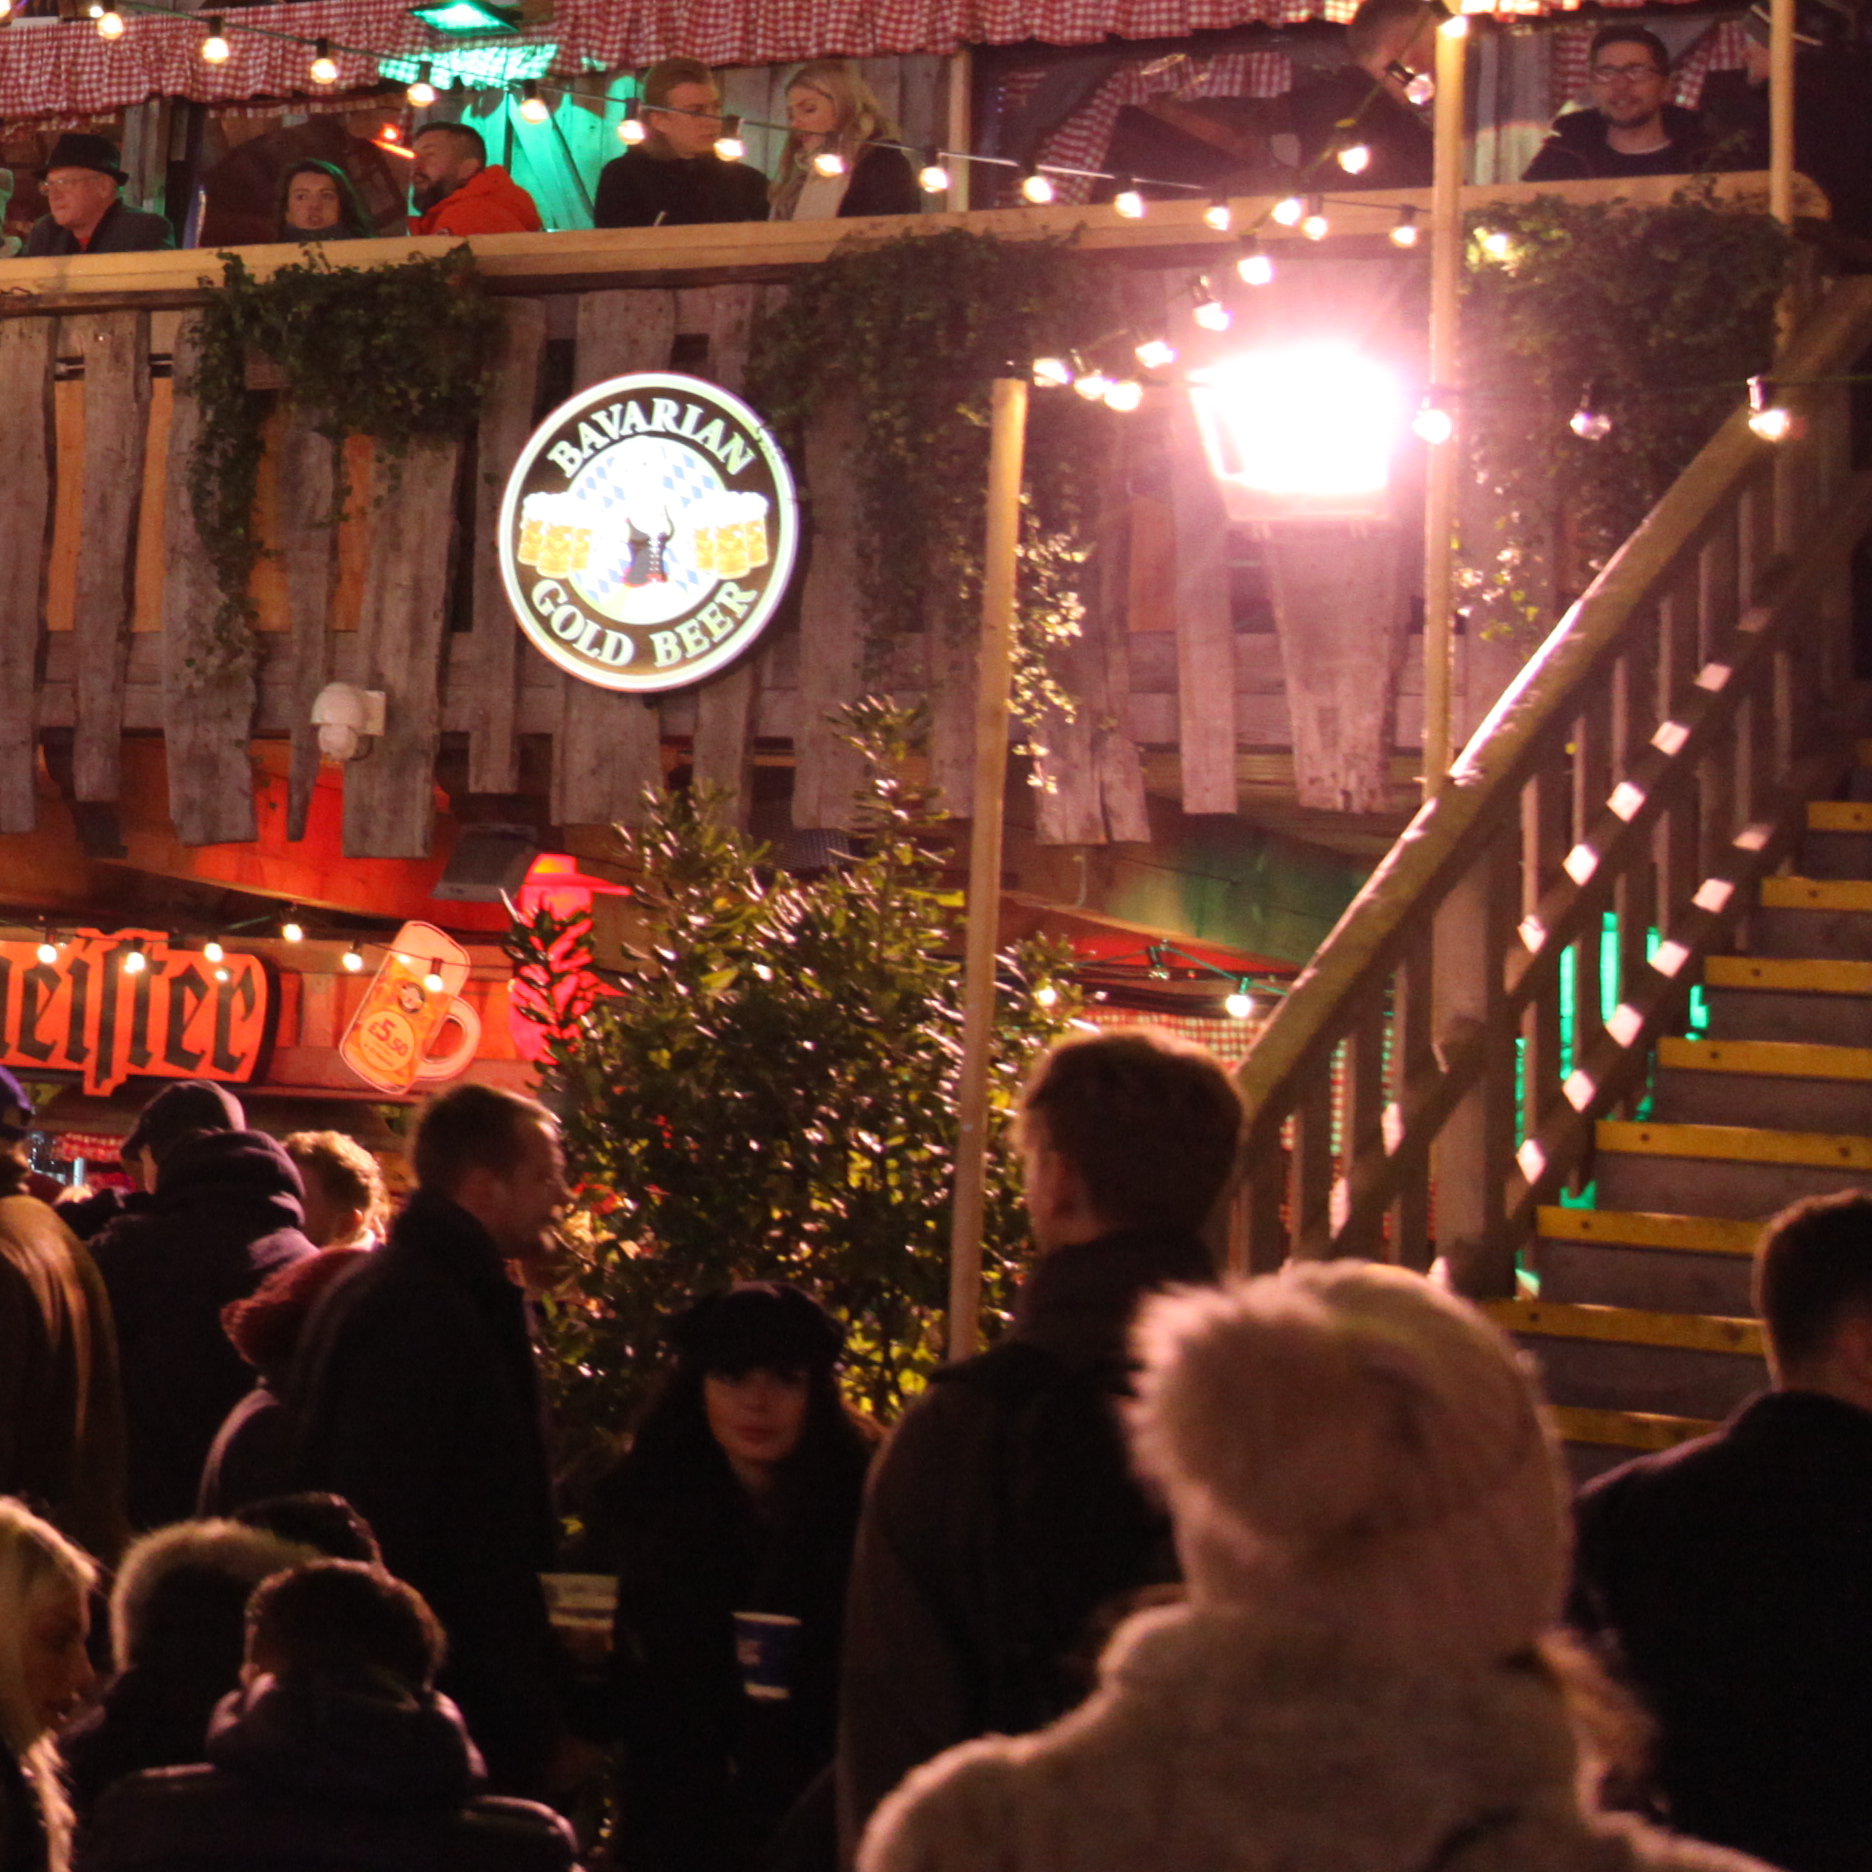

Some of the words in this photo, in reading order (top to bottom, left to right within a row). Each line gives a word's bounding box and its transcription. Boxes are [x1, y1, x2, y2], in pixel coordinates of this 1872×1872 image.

[546, 397, 756, 479] BAVARIAN
[531, 579, 635, 667] GOLD
[648, 581, 758, 667] BEER
